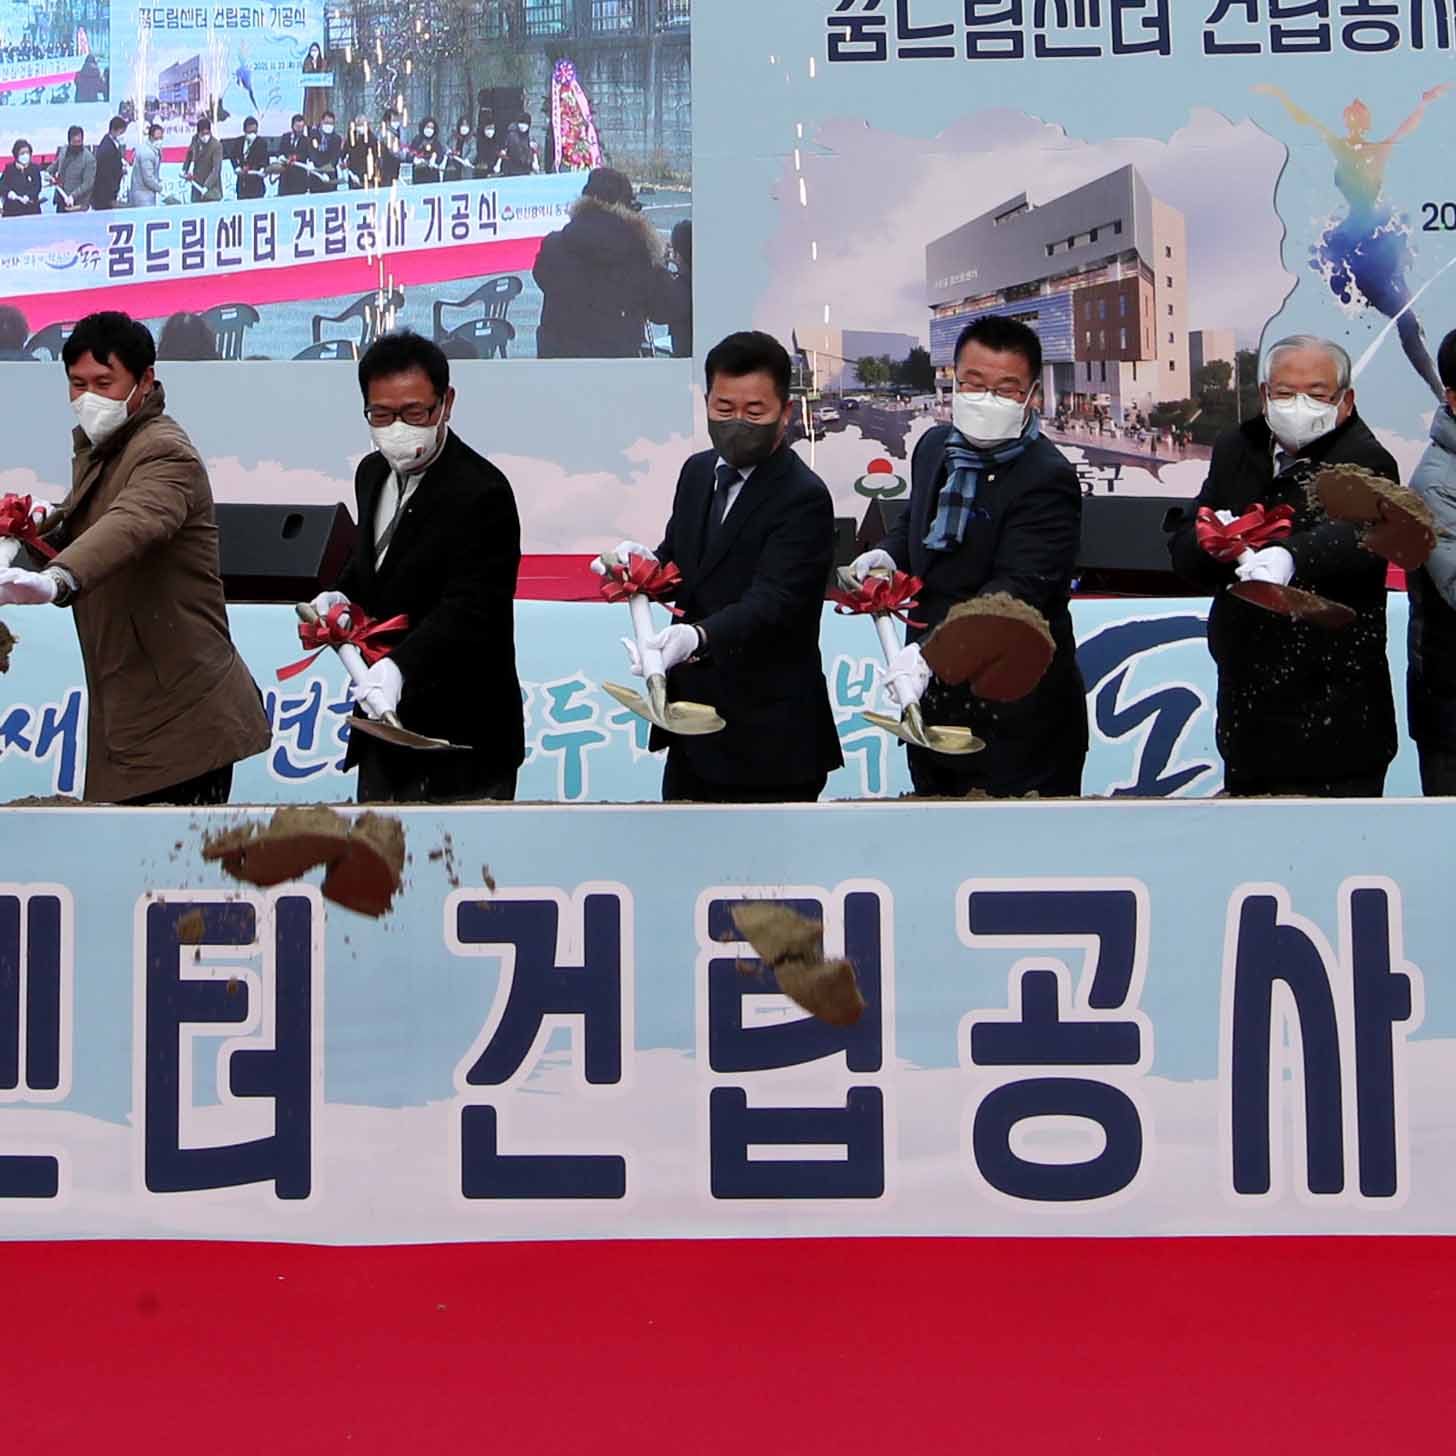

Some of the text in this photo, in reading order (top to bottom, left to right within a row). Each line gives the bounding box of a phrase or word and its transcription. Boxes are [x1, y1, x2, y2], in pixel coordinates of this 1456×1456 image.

[108, 191, 498, 279] 꿈드림센터 건립공사 기공식
[455, 886, 1413, 1202] 건립공사
